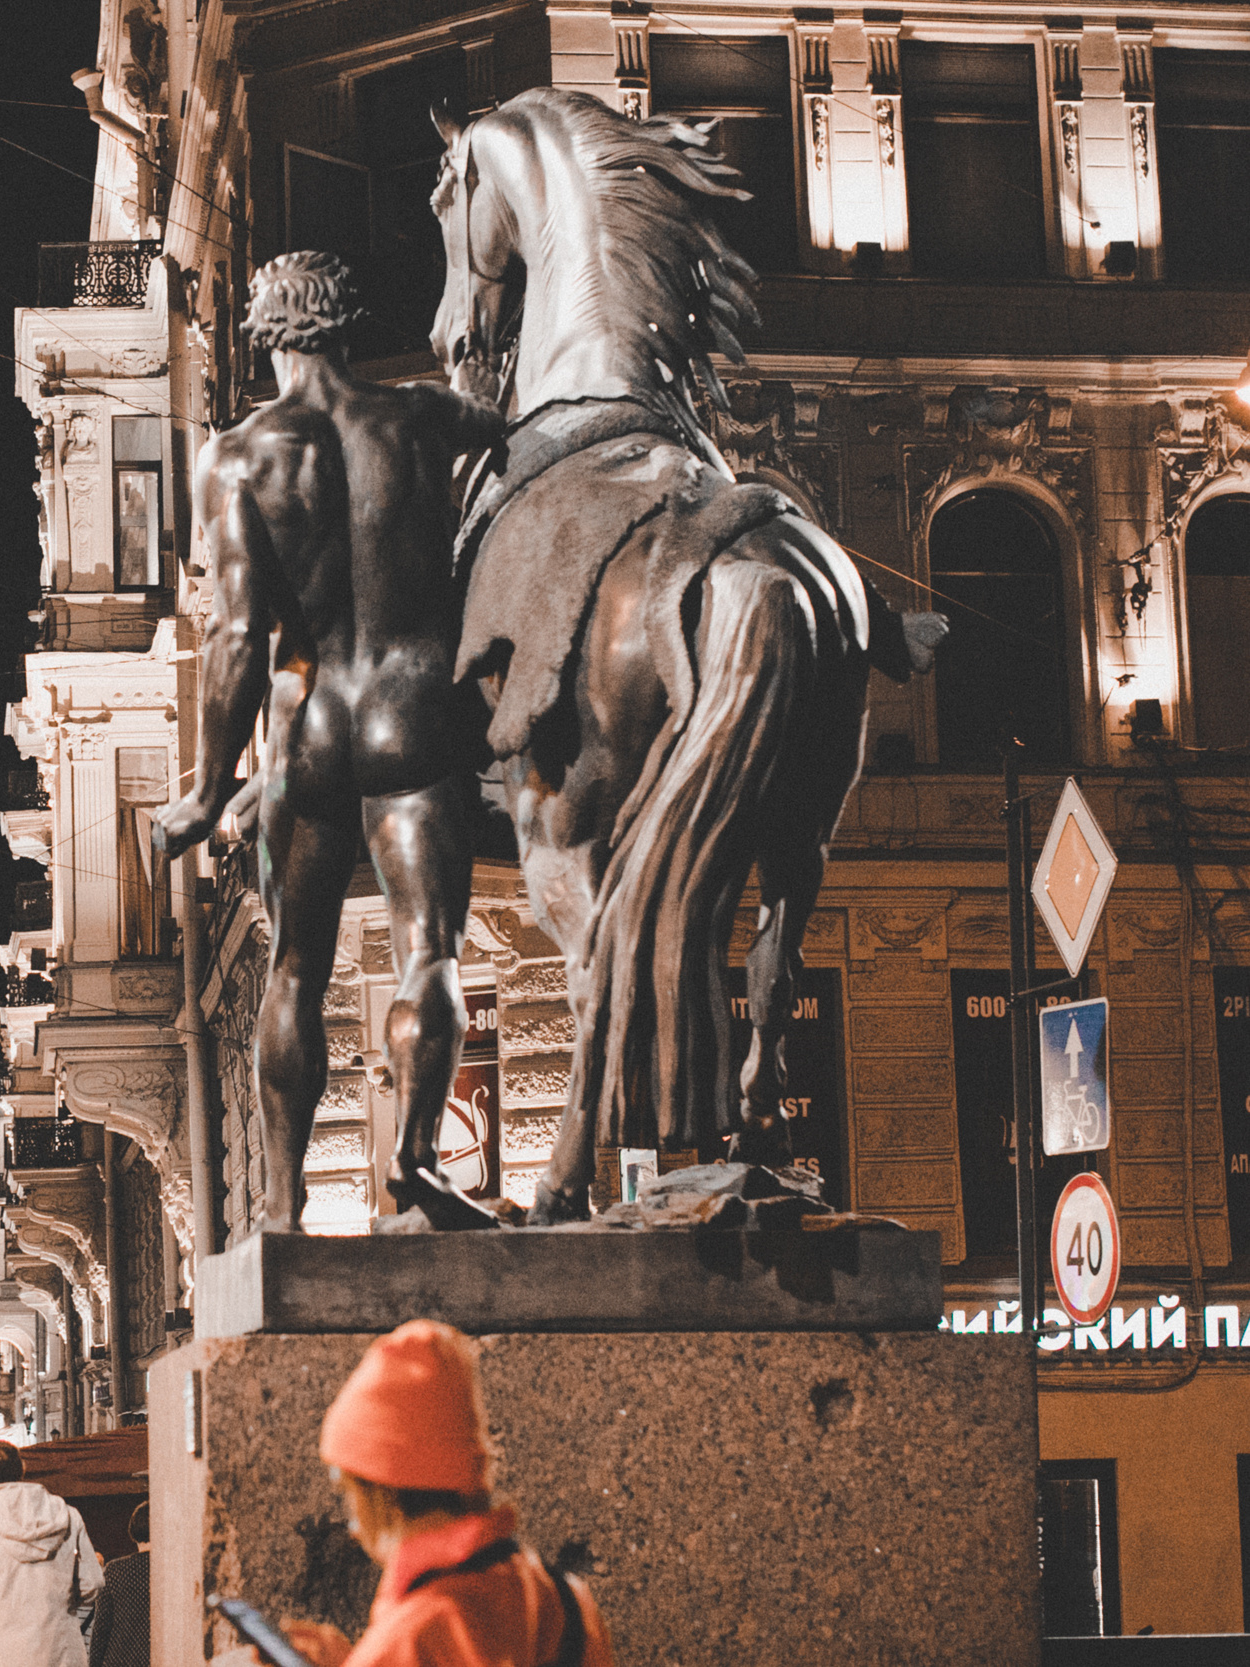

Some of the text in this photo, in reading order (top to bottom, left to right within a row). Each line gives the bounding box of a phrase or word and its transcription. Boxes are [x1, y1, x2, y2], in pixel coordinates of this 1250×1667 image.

[1067, 1221, 1102, 1276] 40
[937, 1295, 1250, 1350] ИЙСКИЙ П
